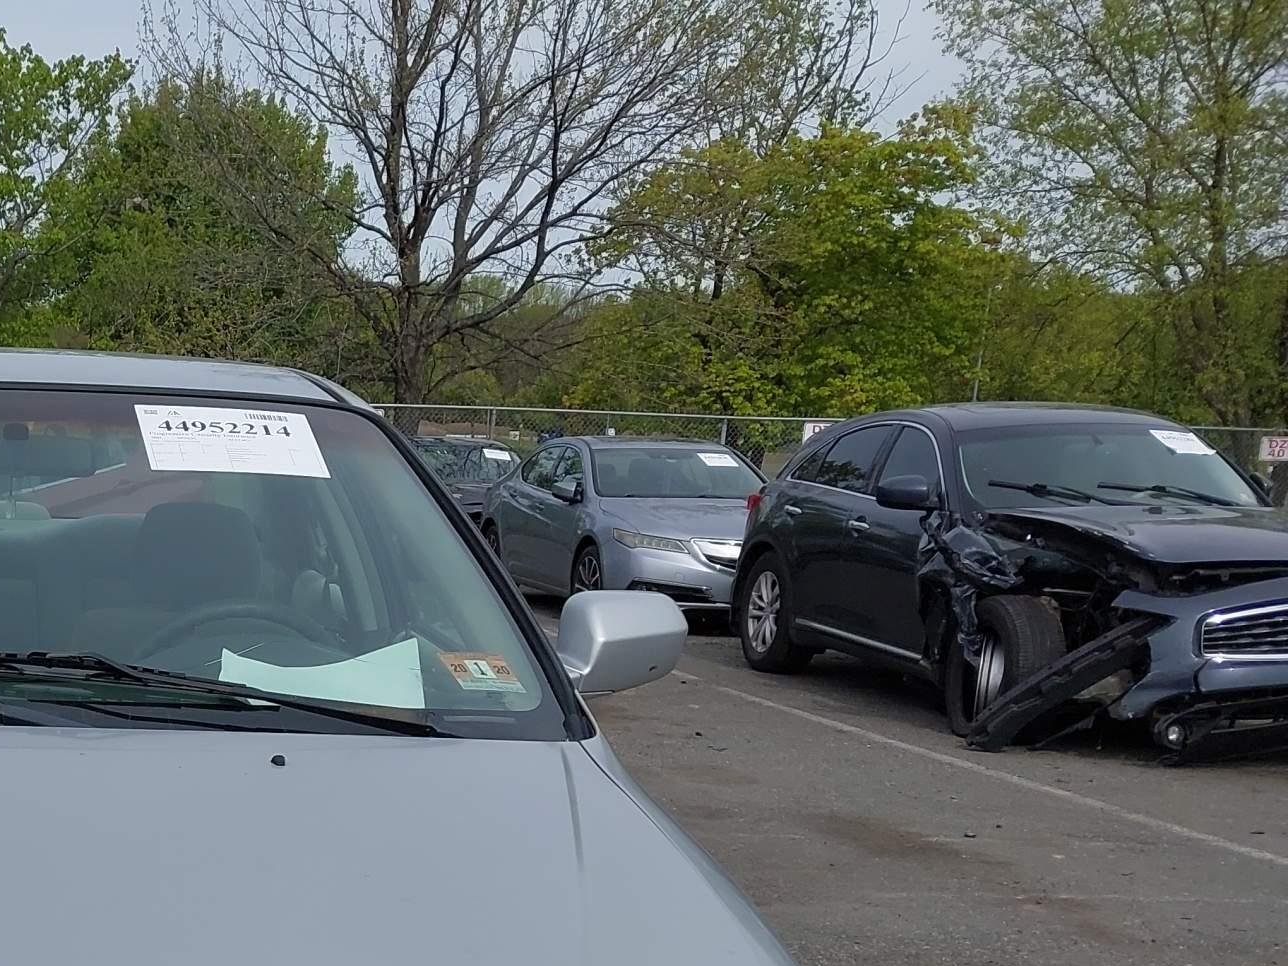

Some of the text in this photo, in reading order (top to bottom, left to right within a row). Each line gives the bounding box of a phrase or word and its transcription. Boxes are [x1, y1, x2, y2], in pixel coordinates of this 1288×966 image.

[158, 419, 291, 437] 44952214
[1269, 440, 1288, 448] DZ
[1268, 449, 1285, 457] 40
[451, 662, 510, 676] 20 1 20
